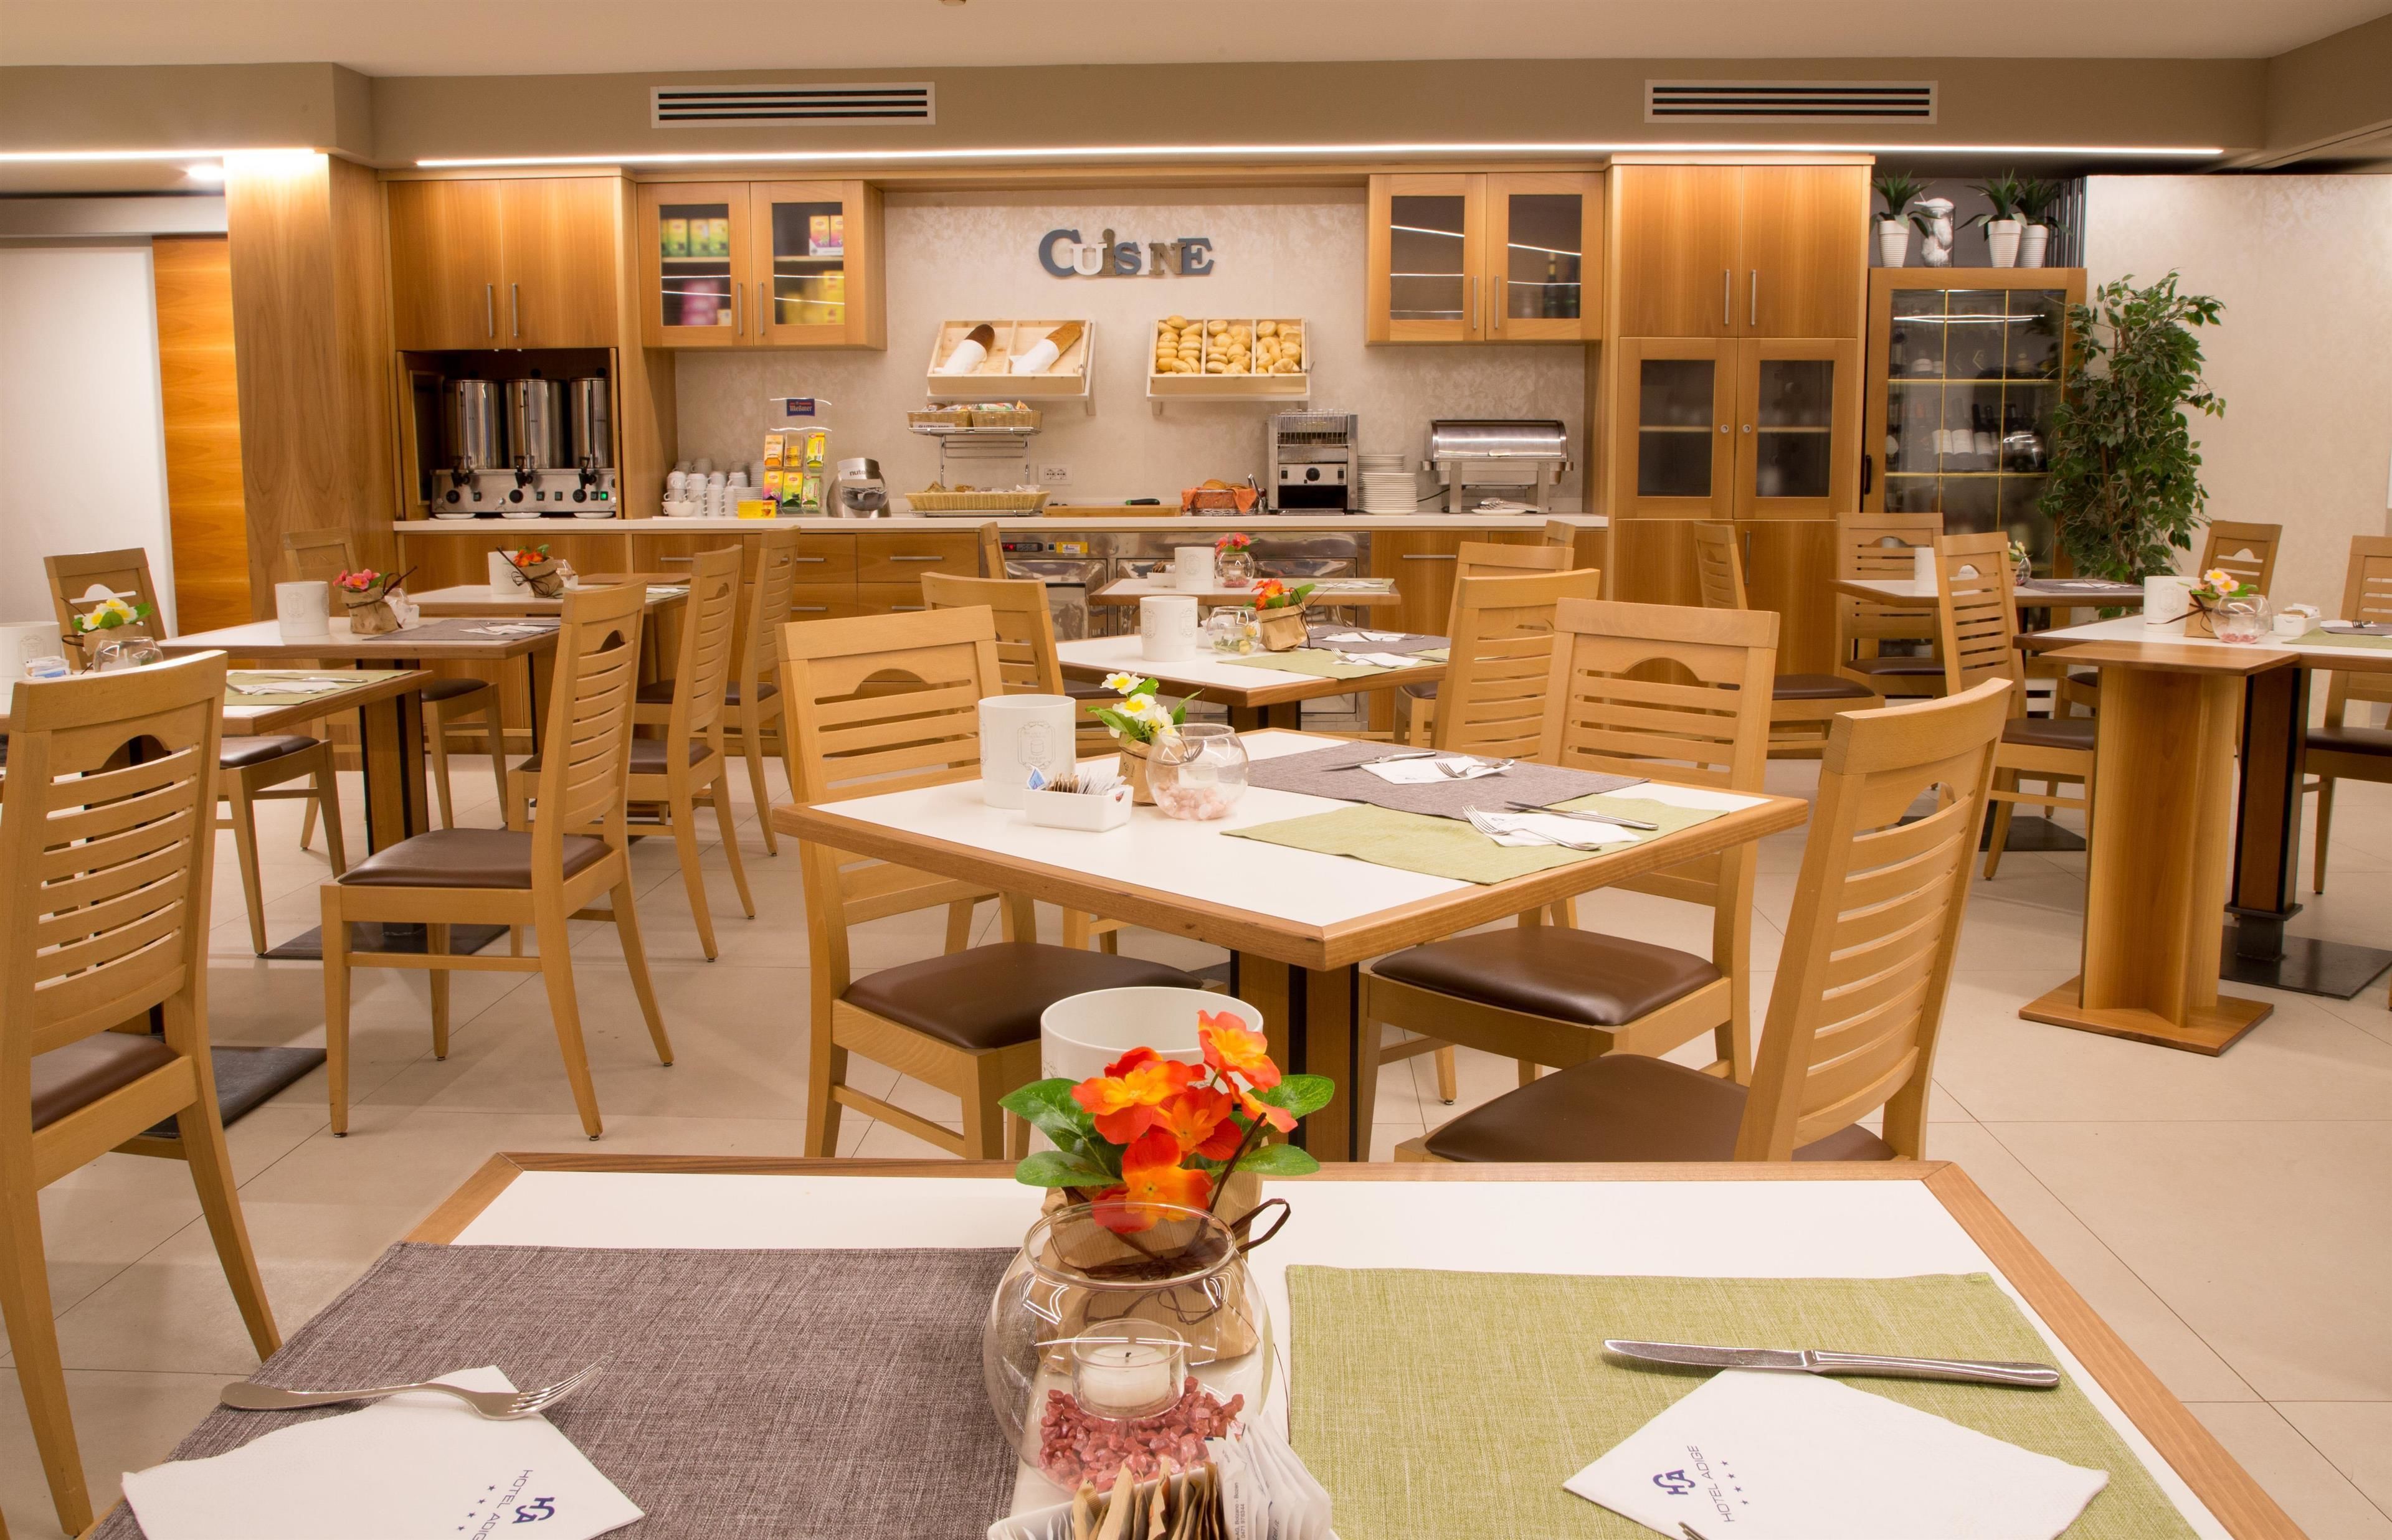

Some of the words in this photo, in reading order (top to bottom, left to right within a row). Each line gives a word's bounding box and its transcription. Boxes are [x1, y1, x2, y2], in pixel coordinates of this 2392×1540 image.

[1687, 1445, 1714, 1480] ADIGE
[496, 1470, 534, 1508] HOTEL
[1707, 1483, 1735, 1522] HOTEL
